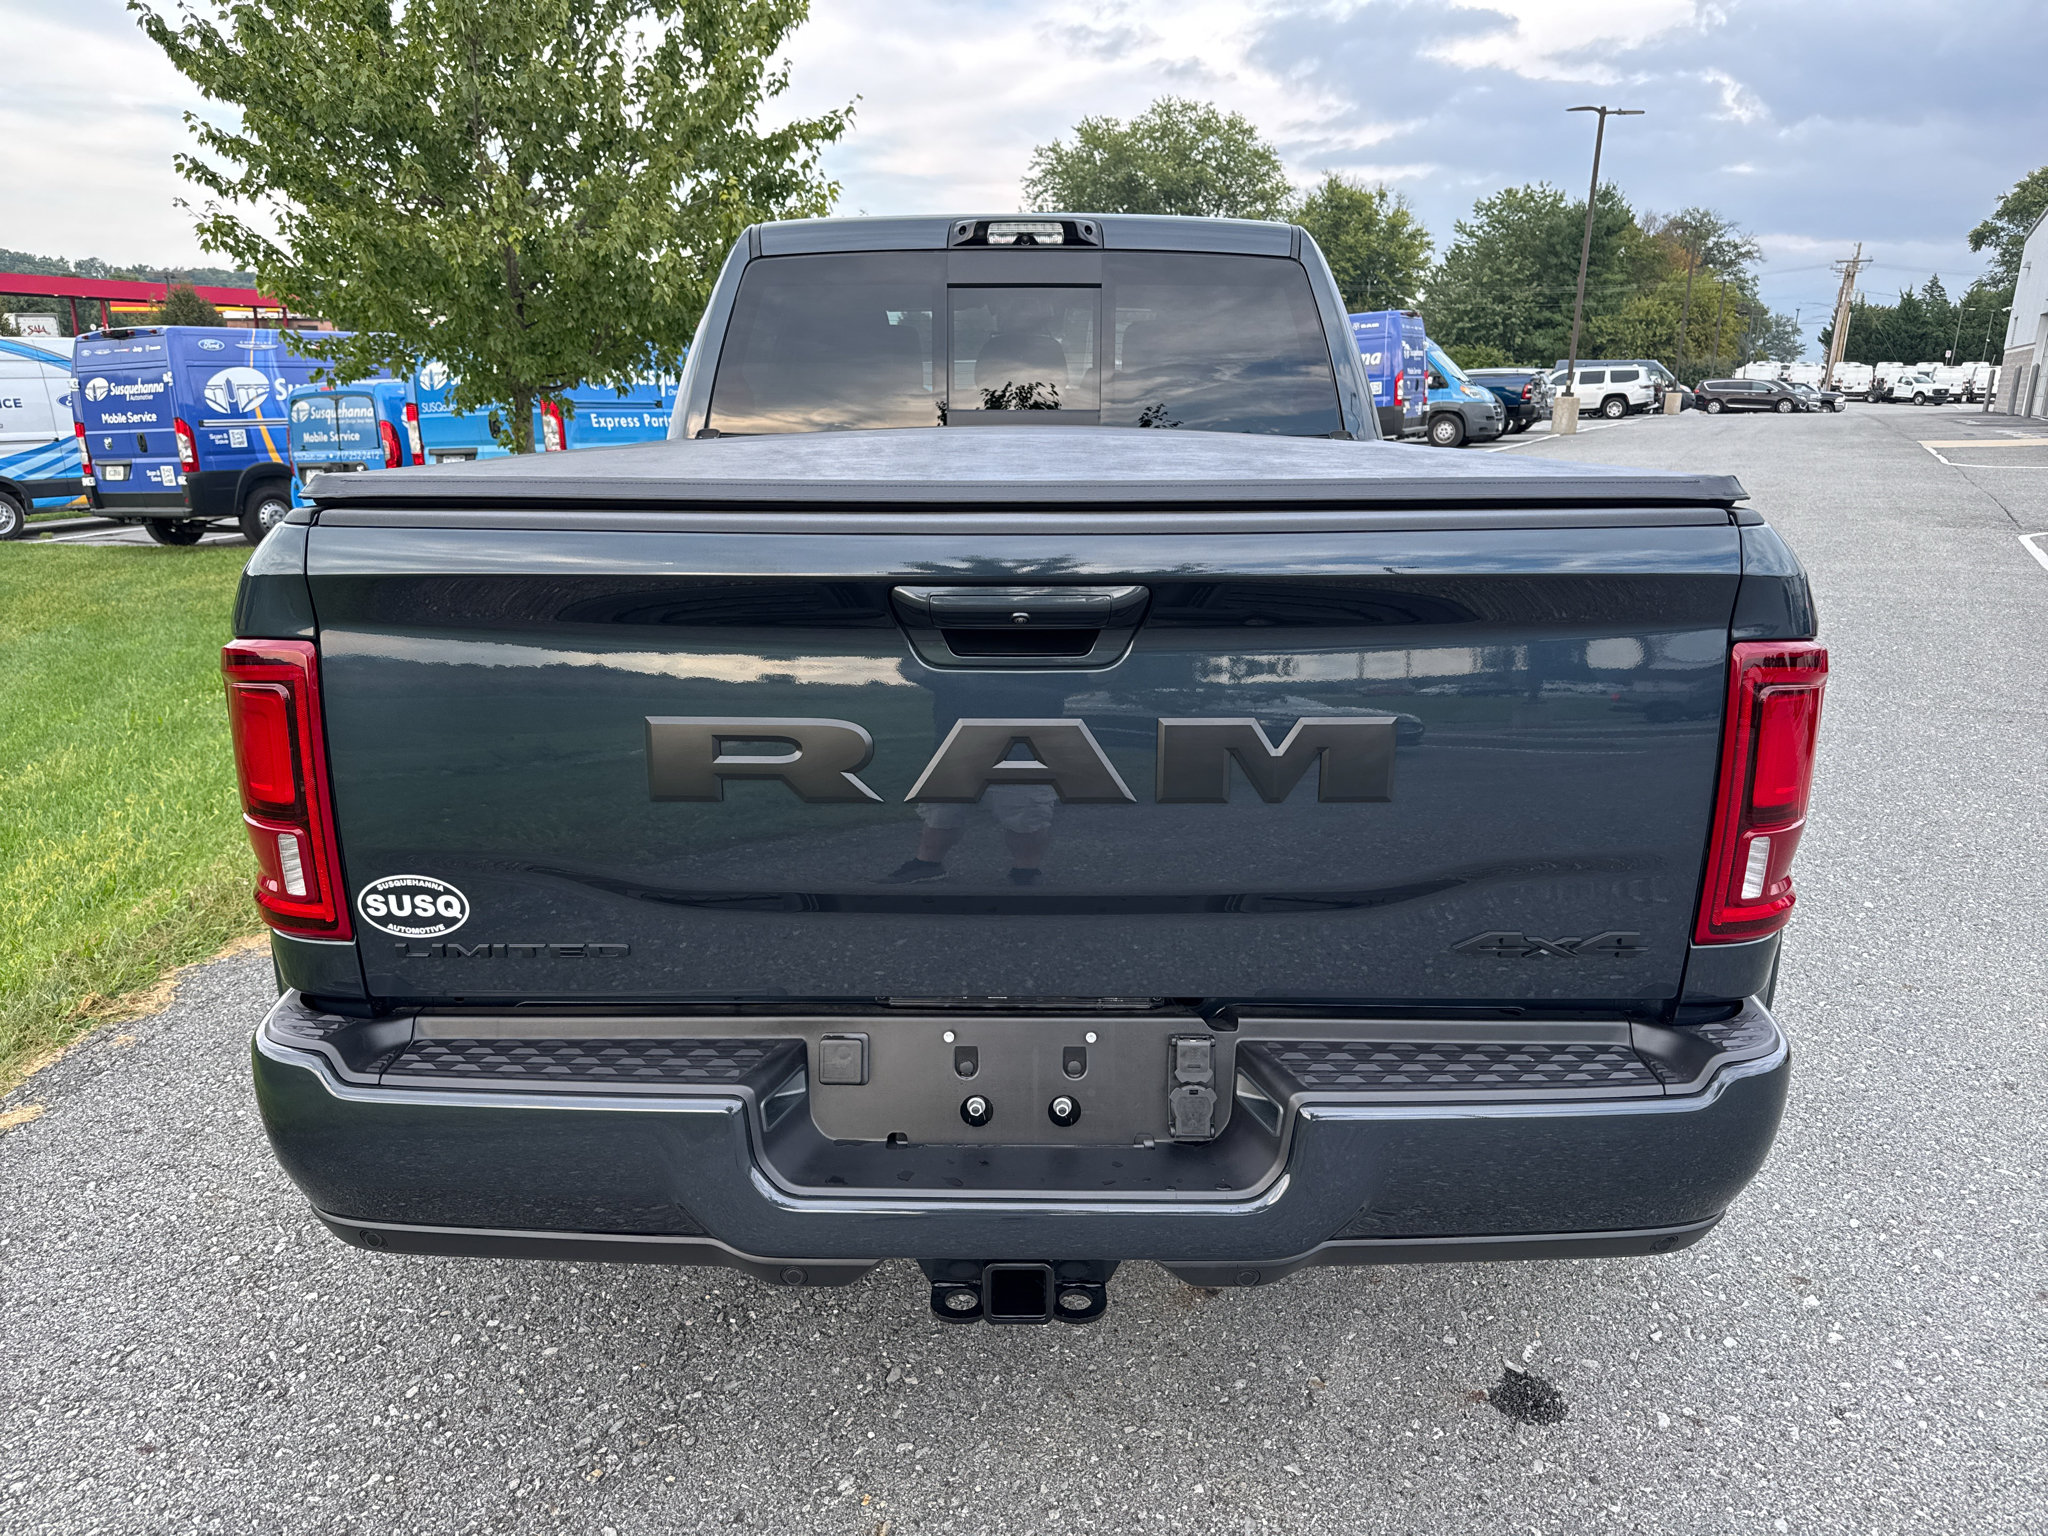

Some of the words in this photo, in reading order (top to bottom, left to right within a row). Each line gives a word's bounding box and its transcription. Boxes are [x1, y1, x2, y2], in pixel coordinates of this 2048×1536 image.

[110, 377, 164, 401] Susquehanna
[101, 412, 127, 424] Mobile
[127, 411, 157, 423] Service
[311, 402, 374, 425] Susquehanna
[590, 413, 640, 431] Express
[303, 431, 328, 443] Mobile
[329, 430, 360, 442] Service
[644, 715, 1400, 804] RAM
[377, 879, 444, 892] SUSQUEHANNA
[366, 894, 462, 919] SUSQ
[387, 923, 446, 935] AUTOMOTIVE
[395, 943, 631, 958] LIMITED
